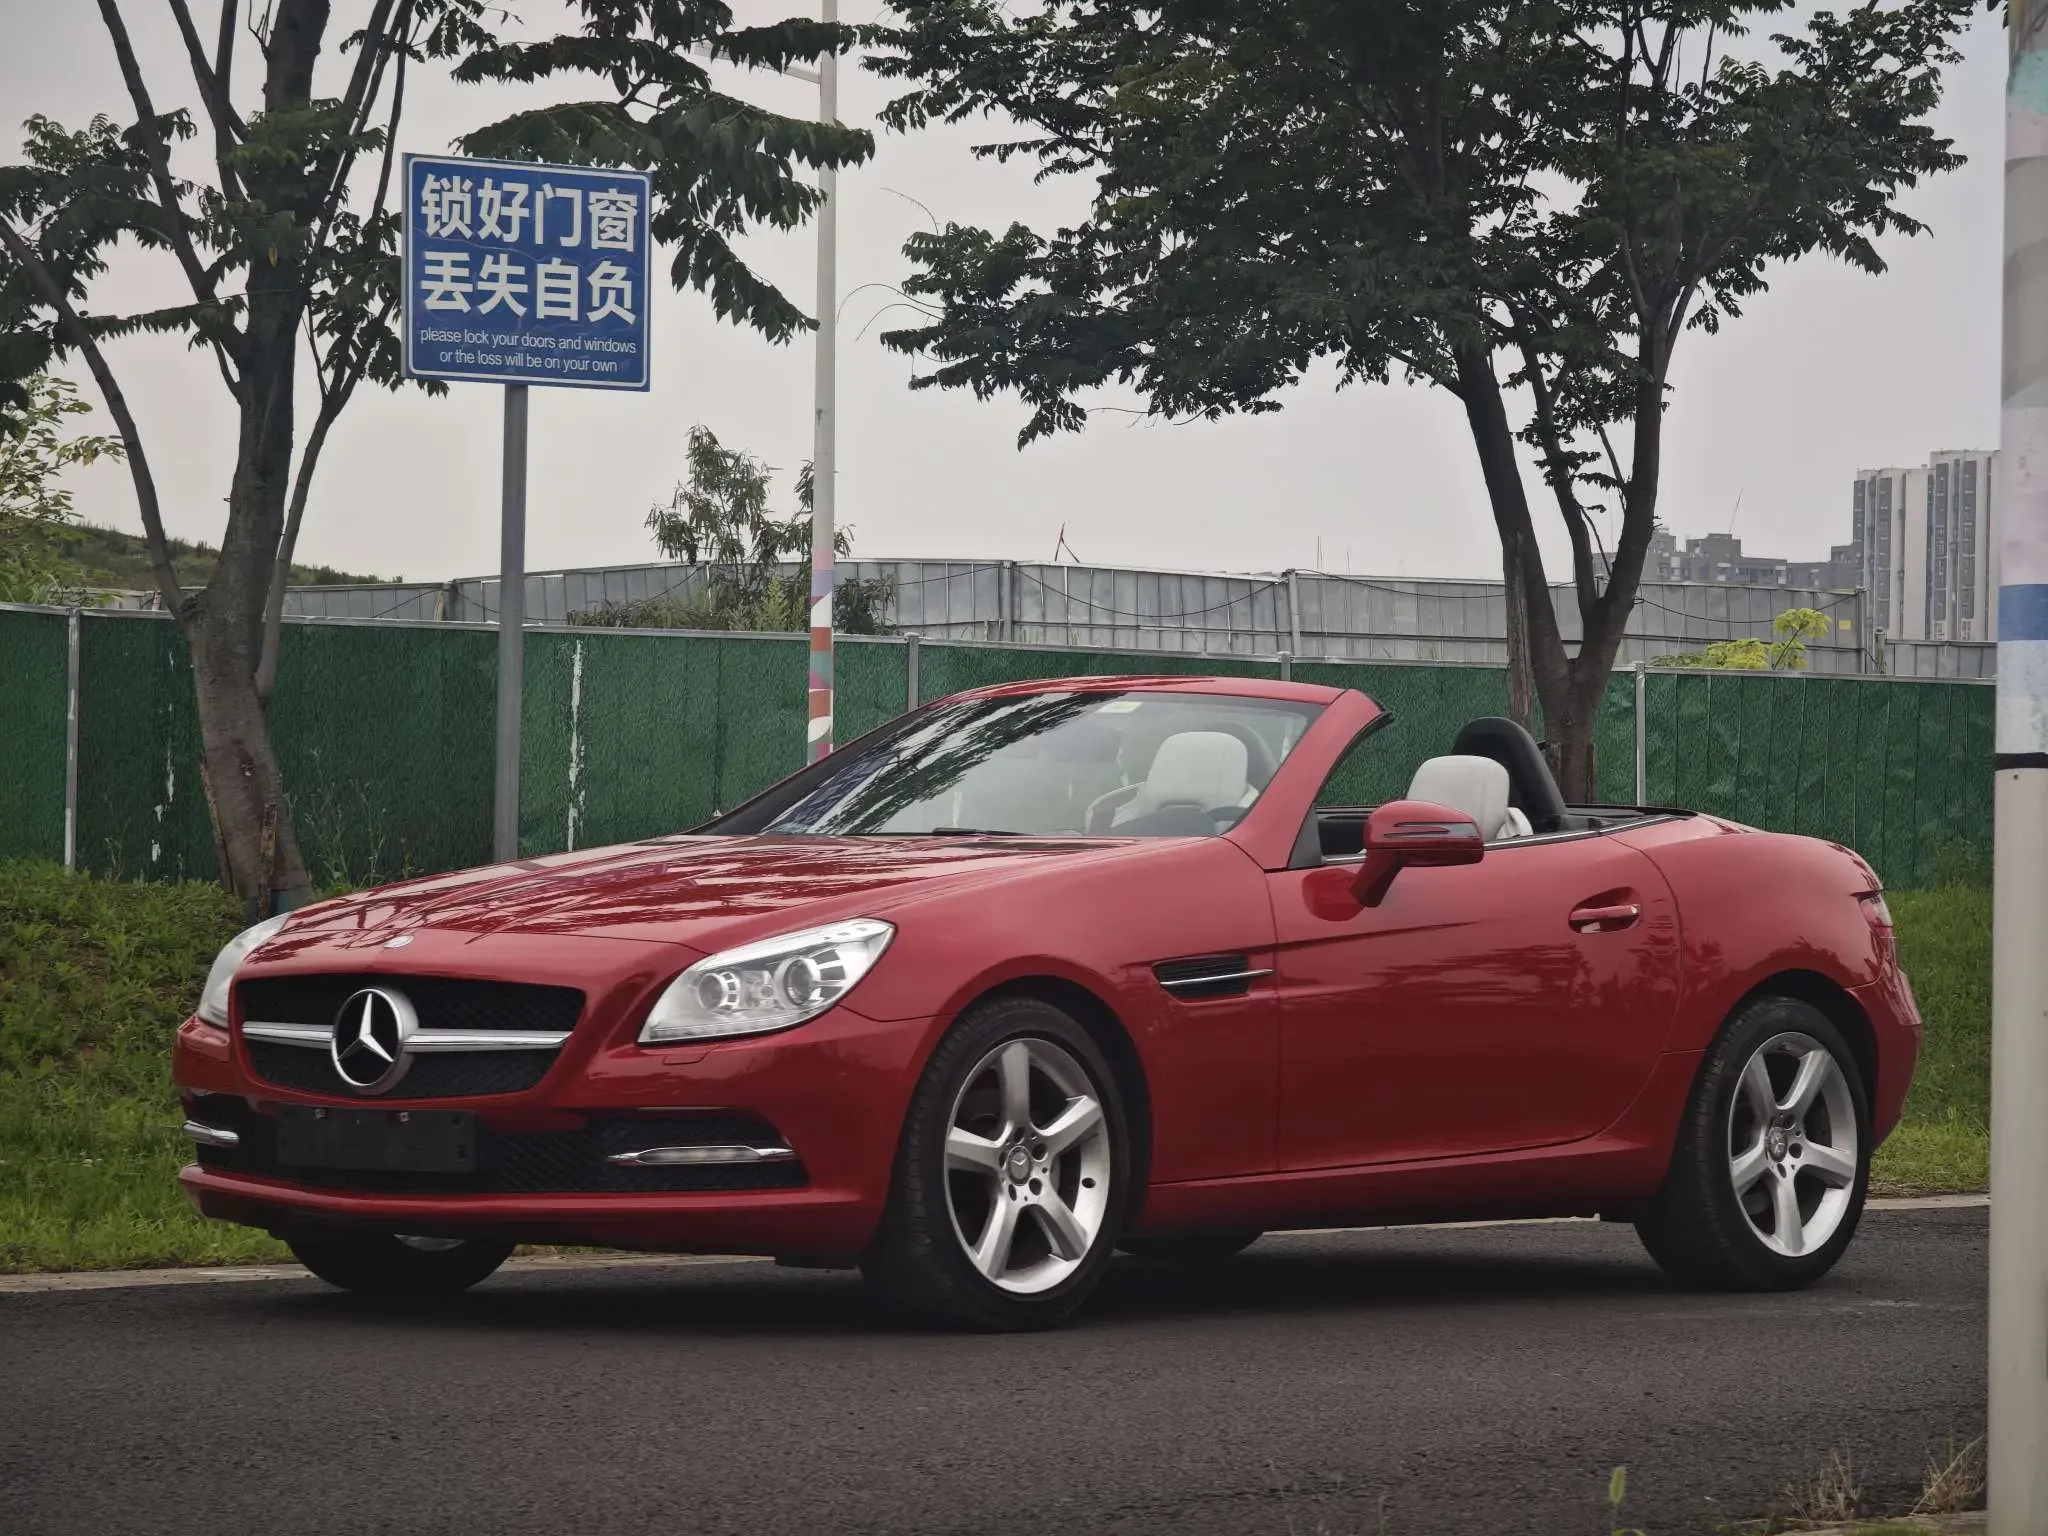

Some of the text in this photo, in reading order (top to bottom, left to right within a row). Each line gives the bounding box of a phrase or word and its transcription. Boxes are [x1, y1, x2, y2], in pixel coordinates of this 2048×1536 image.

[421, 173, 638, 252] 锁好门窗
[421, 251, 637, 325] 丢失自负
[420, 329, 636, 354] please lock your doors and windows
[440, 349, 618, 373] or the loss will be on your own
